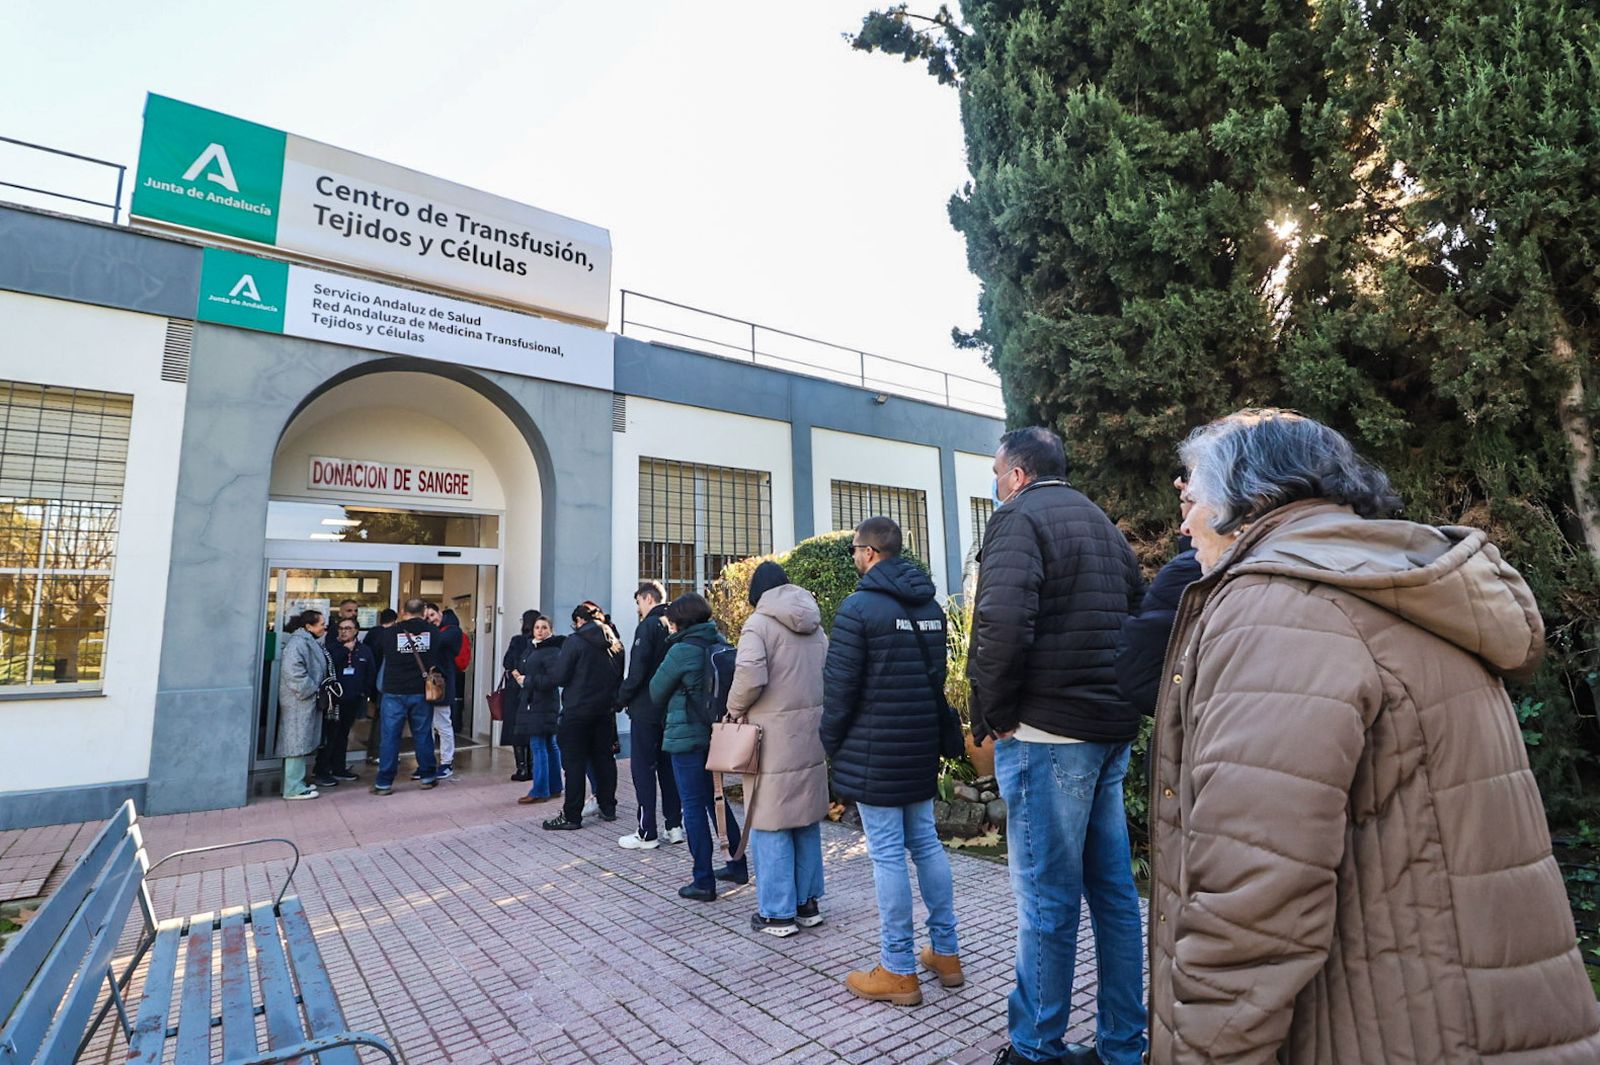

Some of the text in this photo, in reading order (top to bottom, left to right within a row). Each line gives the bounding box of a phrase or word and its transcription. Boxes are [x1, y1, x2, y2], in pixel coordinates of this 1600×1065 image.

[143, 177, 272, 216] Junta de Andalucía
[313, 203, 527, 276] Tejidos y Células
[316, 176, 594, 272] Centro de Transfusión,
[208, 295, 278, 312] Junta de Andalucía
[313, 283, 481, 326] Servicio Andaluz de Salud
[312, 298, 564, 357] Red Andaluza de Medicina Transfusional,
[312, 312, 425, 343] Tejidos y Células
[312, 461, 469, 495] DONACION DE SANGRE
